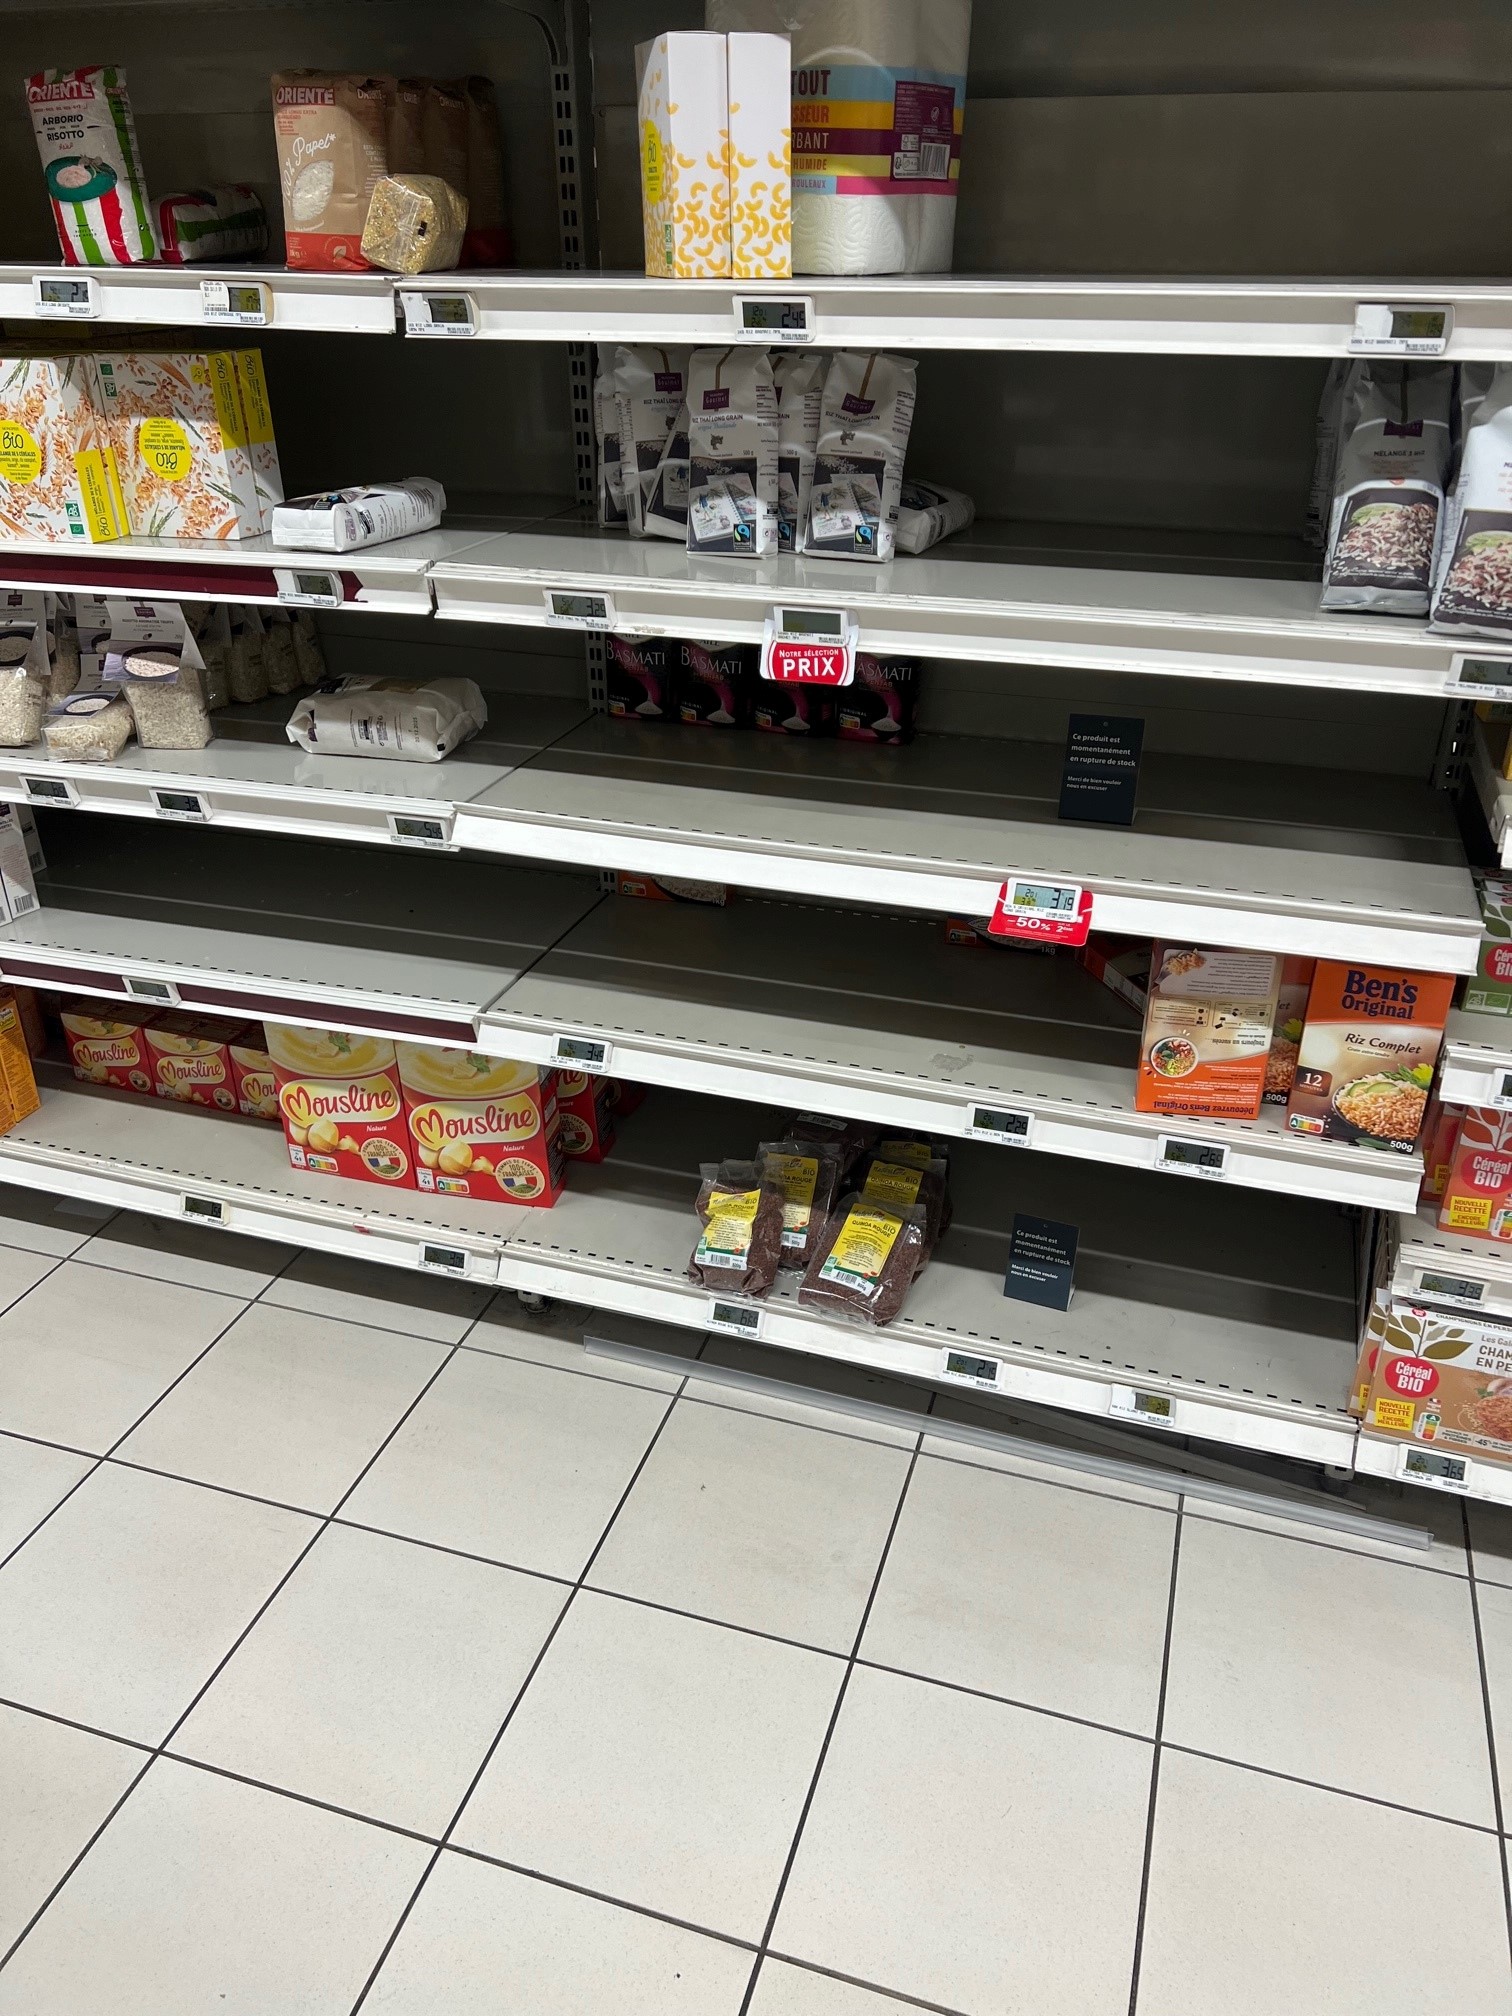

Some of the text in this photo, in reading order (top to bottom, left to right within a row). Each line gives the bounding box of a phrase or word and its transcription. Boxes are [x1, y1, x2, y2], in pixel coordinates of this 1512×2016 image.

[28, 80, 94, 102] ORIENTE
[276, 88, 334, 105] ORIENTE
[42, 114, 84, 126] ARBORIO
[47, 129, 85, 142] RISOTTO
[607, 640, 666, 666] BASMATI
[681, 645, 743, 675] BASMATI
[783, 656, 836, 678] PRIX
[855, 663, 913, 681] ASMATI
[1072, 746, 1130, 755] momentanément
[1344, 970, 1419, 1004] Ben's
[1341, 995, 1415, 1020] Original
[1345, 1033, 1365, 1045] Riz
[1369, 1037, 1422, 1055] Complet
[77, 1042, 137, 1071] Mousline
[161, 1058, 223, 1087] Mousline
[1304, 1072, 1323, 1087] 12
[285, 1084, 395, 1122] Mousline
[1154, 1100, 1189, 1110] Original
[1265, 1093, 1287, 1104] 500g
[1212, 1105, 1255, 1115] Découvrez
[366, 1124, 387, 1132] Nature
[416, 1105, 535, 1144] Mousline
[1390, 1140, 1413, 1152] 500g
[1473, 1155, 1511, 1175] Céréal
[803, 1168, 816, 1176] BIO
[905, 1176, 919, 1184] BIO
[1474, 1171, 1502, 1188] BIO
[1453, 1205, 1488, 1215] RECETTE
[1454, 1199, 1488, 1208] NOUVELLE
[1457, 1213, 1482, 1221] ENCORE
[873, 1224, 892, 1238] ROUGE
[882, 1223, 897, 1236] BIO
[1025, 1233, 1047, 1241] produit
[1015, 1240, 1066, 1255] momentanément
[1023, 1250, 1045, 1259] rupture
[1055, 1257, 1070, 1266] stock
[1481, 1334, 1496, 1344] Les
[1476, 1357, 1493, 1368] EN
[1395, 1361, 1433, 1381] Céréal
[1397, 1375, 1424, 1393] BIO
[1378, 1406, 1411, 1417] RECETTE
[1379, 1400, 1412, 1411] NOUVELLE
[1377, 1419, 1410, 1428] MEILLEURE
[1382, 1415, 1406, 1424] ENCORE
